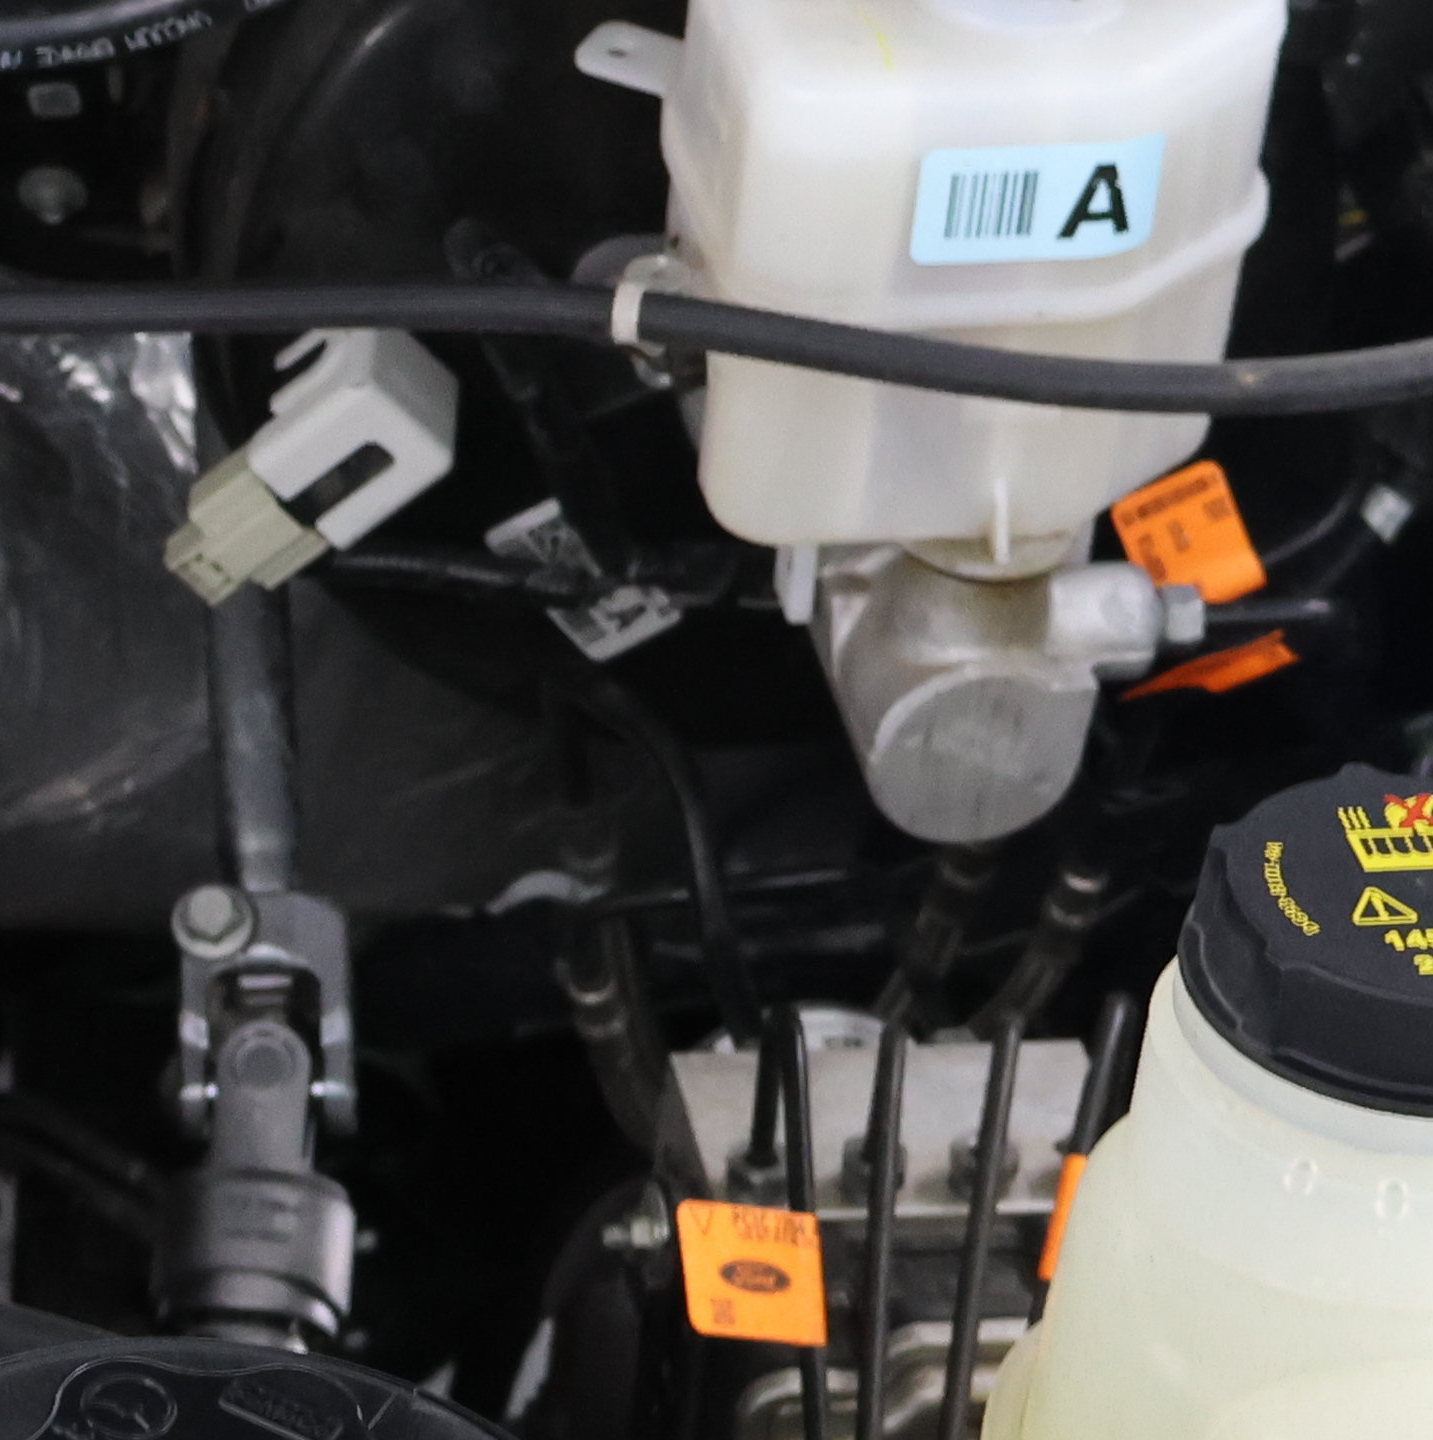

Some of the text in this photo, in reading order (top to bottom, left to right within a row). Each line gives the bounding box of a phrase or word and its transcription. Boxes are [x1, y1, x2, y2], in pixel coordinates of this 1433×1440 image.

[35, 35, 116, 69] BRAKE
[123, 10, 215, 52] VACUUM
[1057, 163, 1129, 240] A
